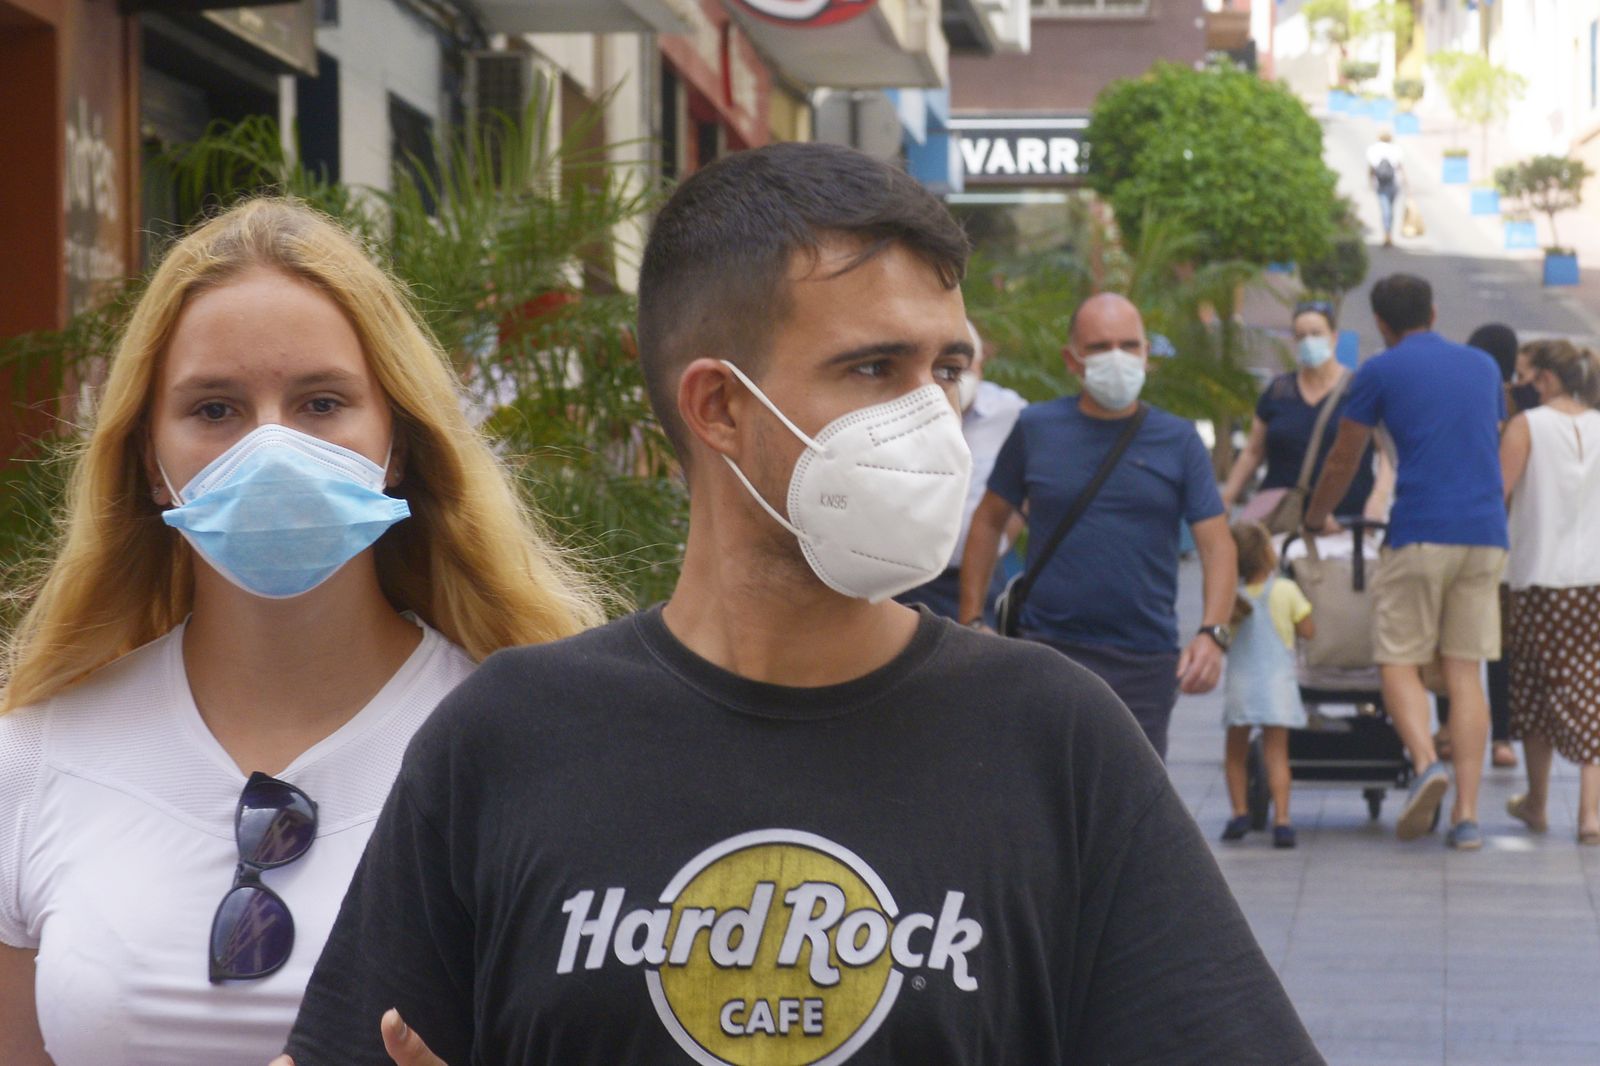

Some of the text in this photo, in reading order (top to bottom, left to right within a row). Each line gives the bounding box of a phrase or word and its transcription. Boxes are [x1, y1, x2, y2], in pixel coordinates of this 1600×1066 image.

[960, 137, 1090, 174] VARR
[820, 493, 848, 510] KN95
[556, 881, 984, 992] Hard Rock
[719, 999, 824, 1036] CAFE
